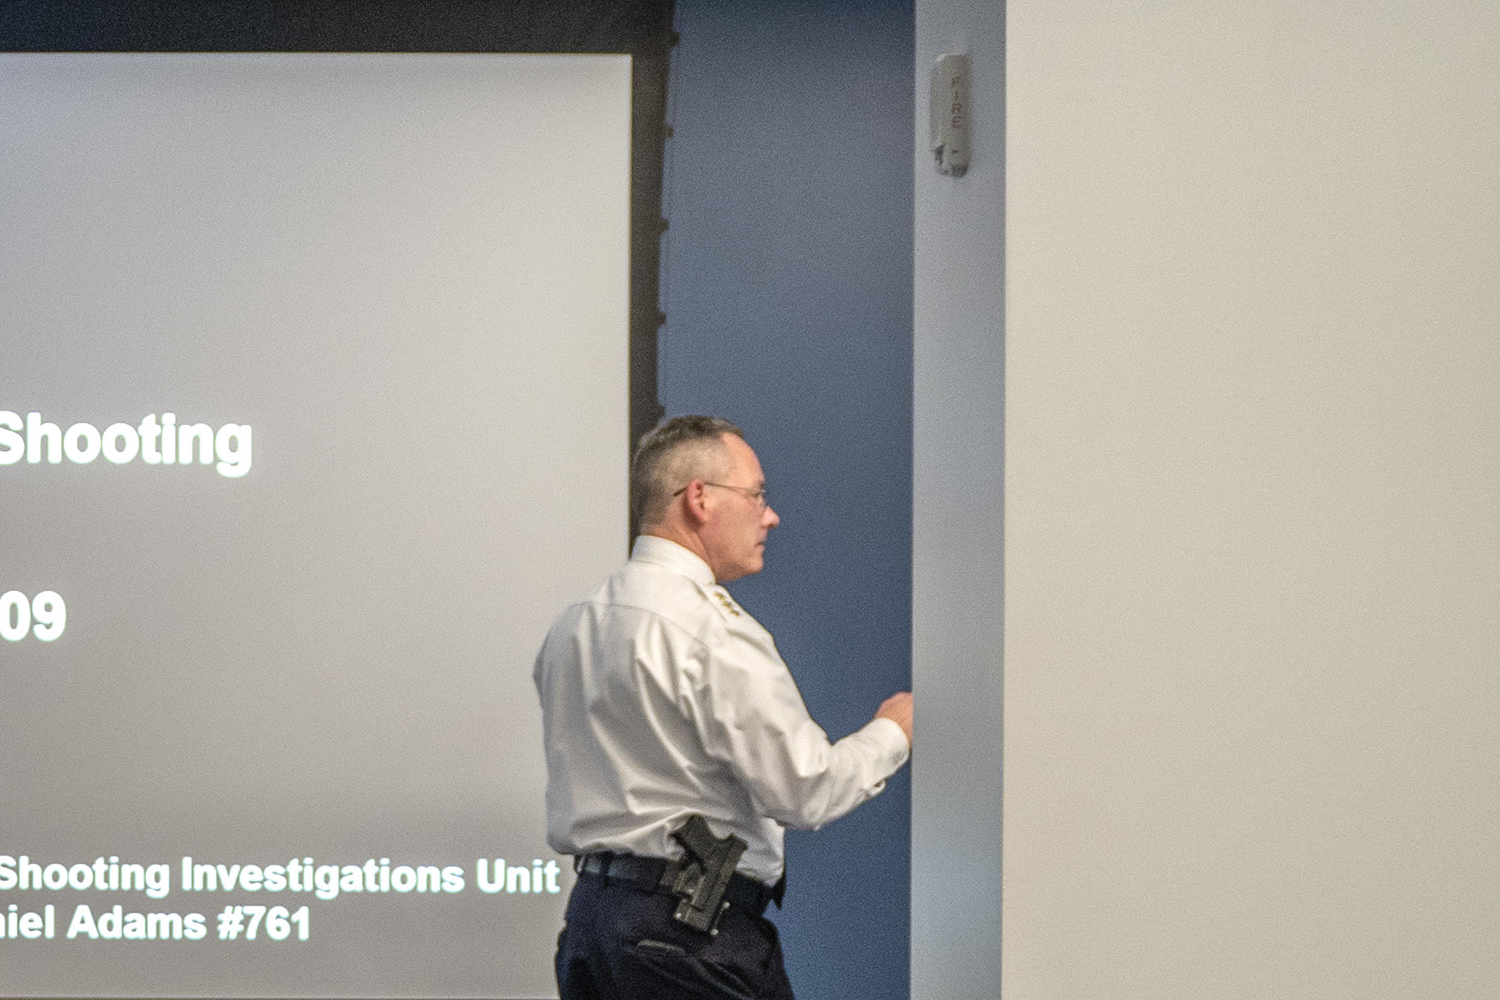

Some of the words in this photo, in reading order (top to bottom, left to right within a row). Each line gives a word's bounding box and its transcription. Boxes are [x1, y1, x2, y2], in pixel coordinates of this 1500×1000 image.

[181, 856, 466, 900] Investigations
[476, 858, 561, 893] Unit
[66, 904, 207, 940] Adams
[217, 905, 310, 941] #761
